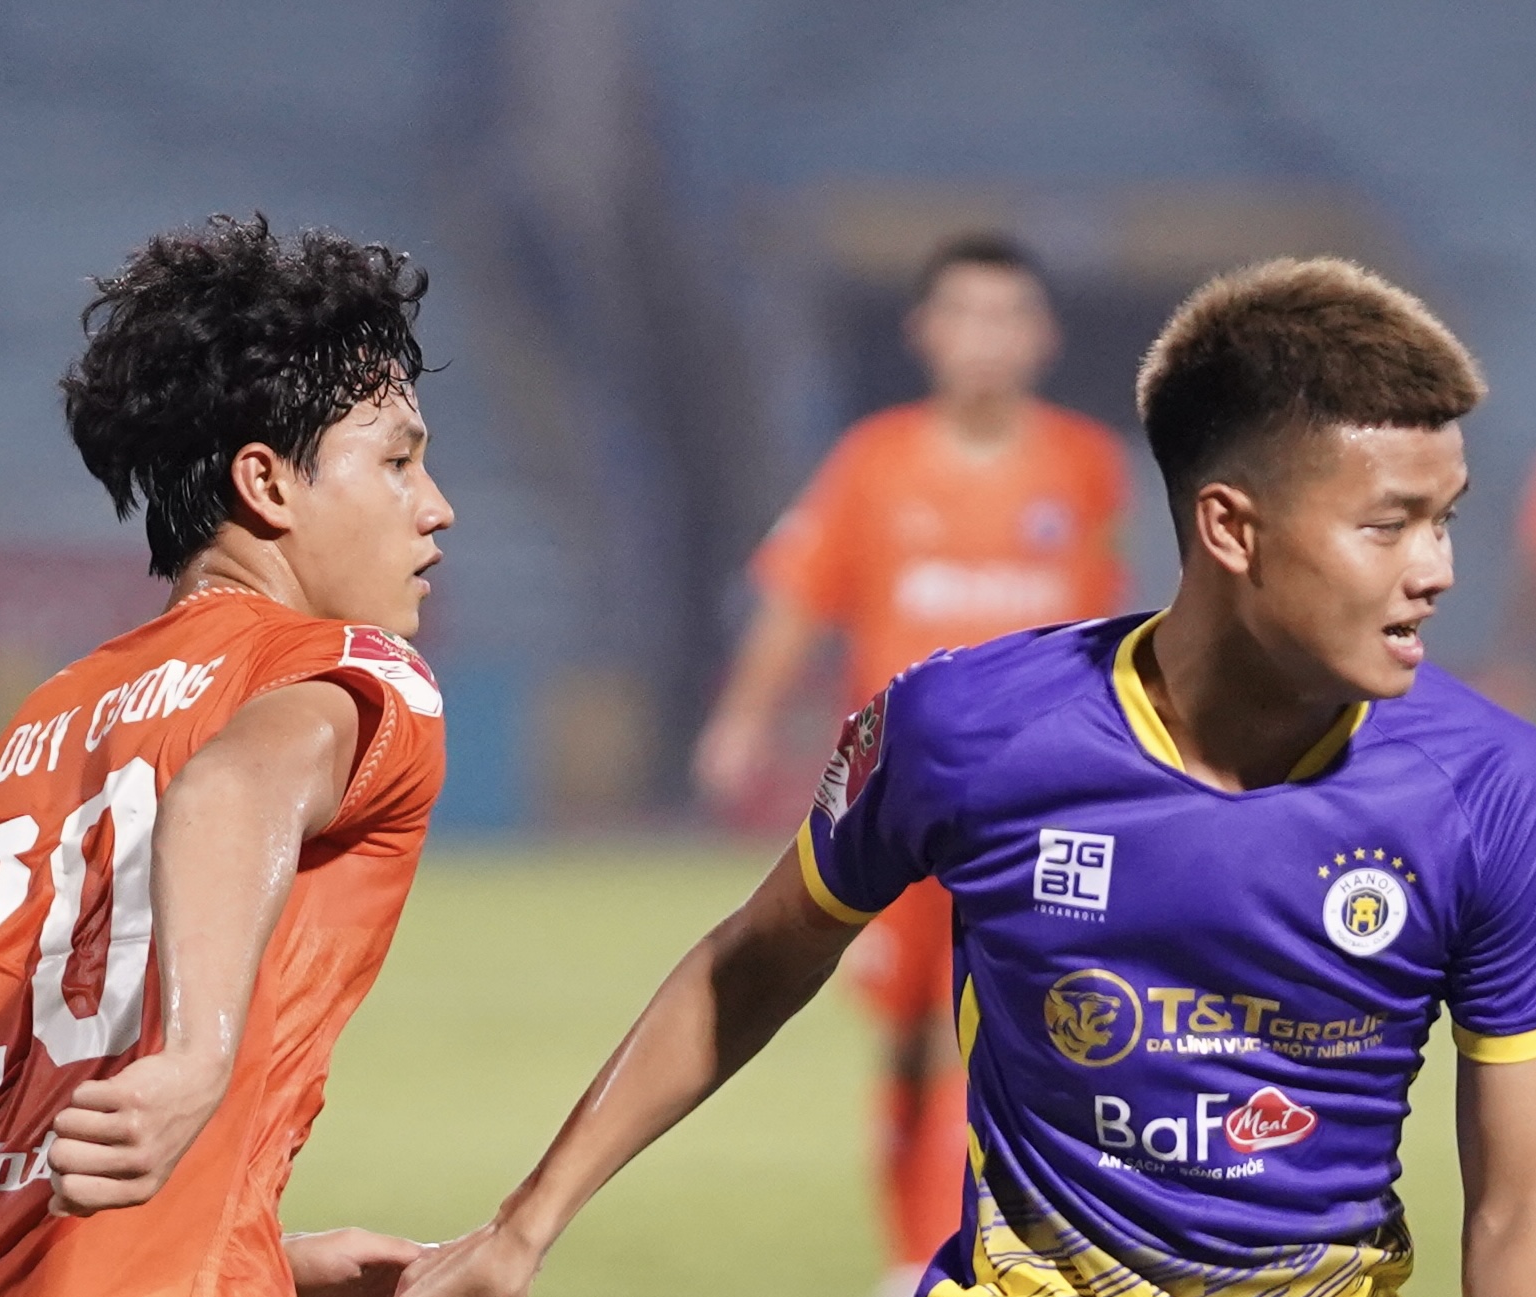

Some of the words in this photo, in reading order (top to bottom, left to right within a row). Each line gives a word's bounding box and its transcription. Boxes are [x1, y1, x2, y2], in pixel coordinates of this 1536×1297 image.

[1339, 873, 1395, 894] HANOI
[1148, 987, 1281, 1034] T&T
[1269, 1012, 1388, 1041] GROUP
[1094, 1093, 1229, 1162] BaF
[1233, 1105, 1305, 1139] Meat
